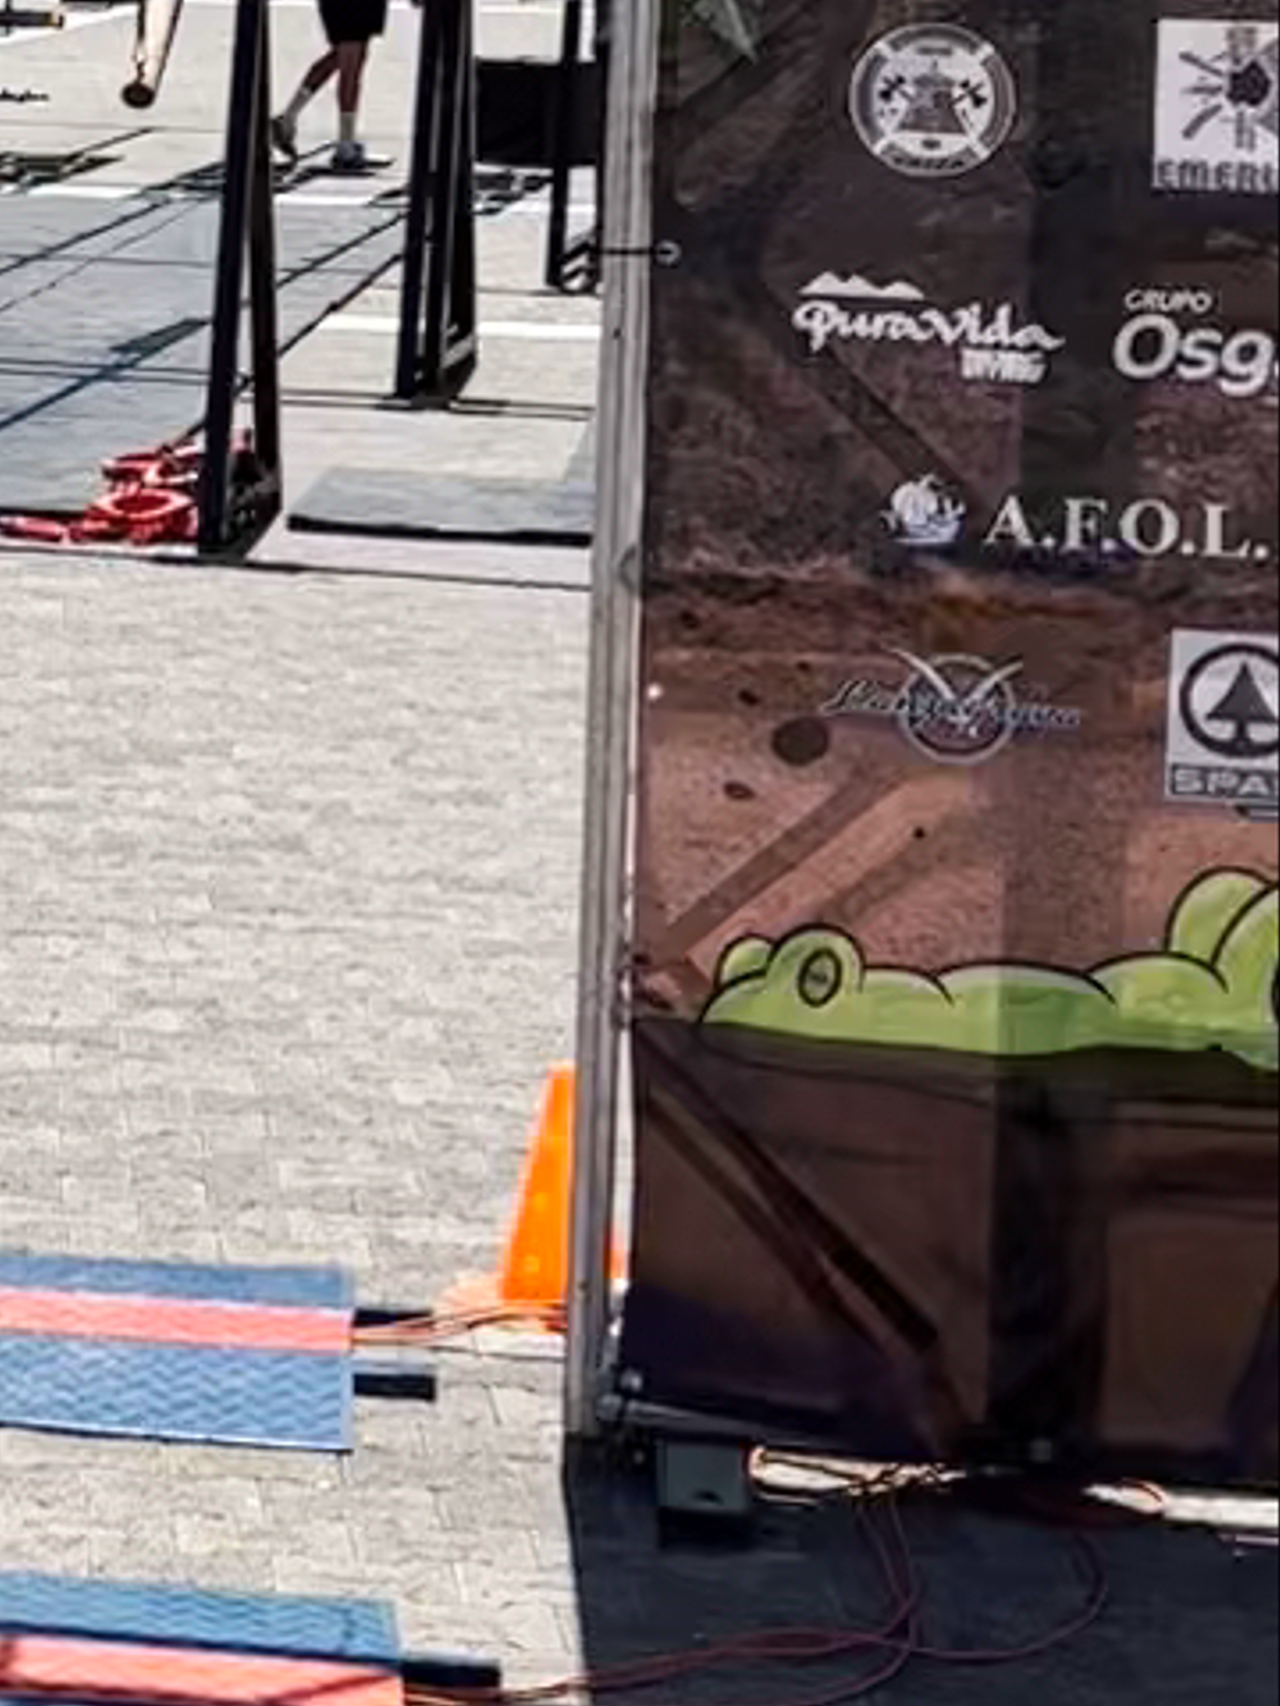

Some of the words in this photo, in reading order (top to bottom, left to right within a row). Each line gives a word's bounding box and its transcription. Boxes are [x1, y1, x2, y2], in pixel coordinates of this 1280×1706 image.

[1113, 312, 1278, 398] Osg
[983, 494, 1271, 561] A.F.O.L.
[1174, 768, 1278, 796] SPA
